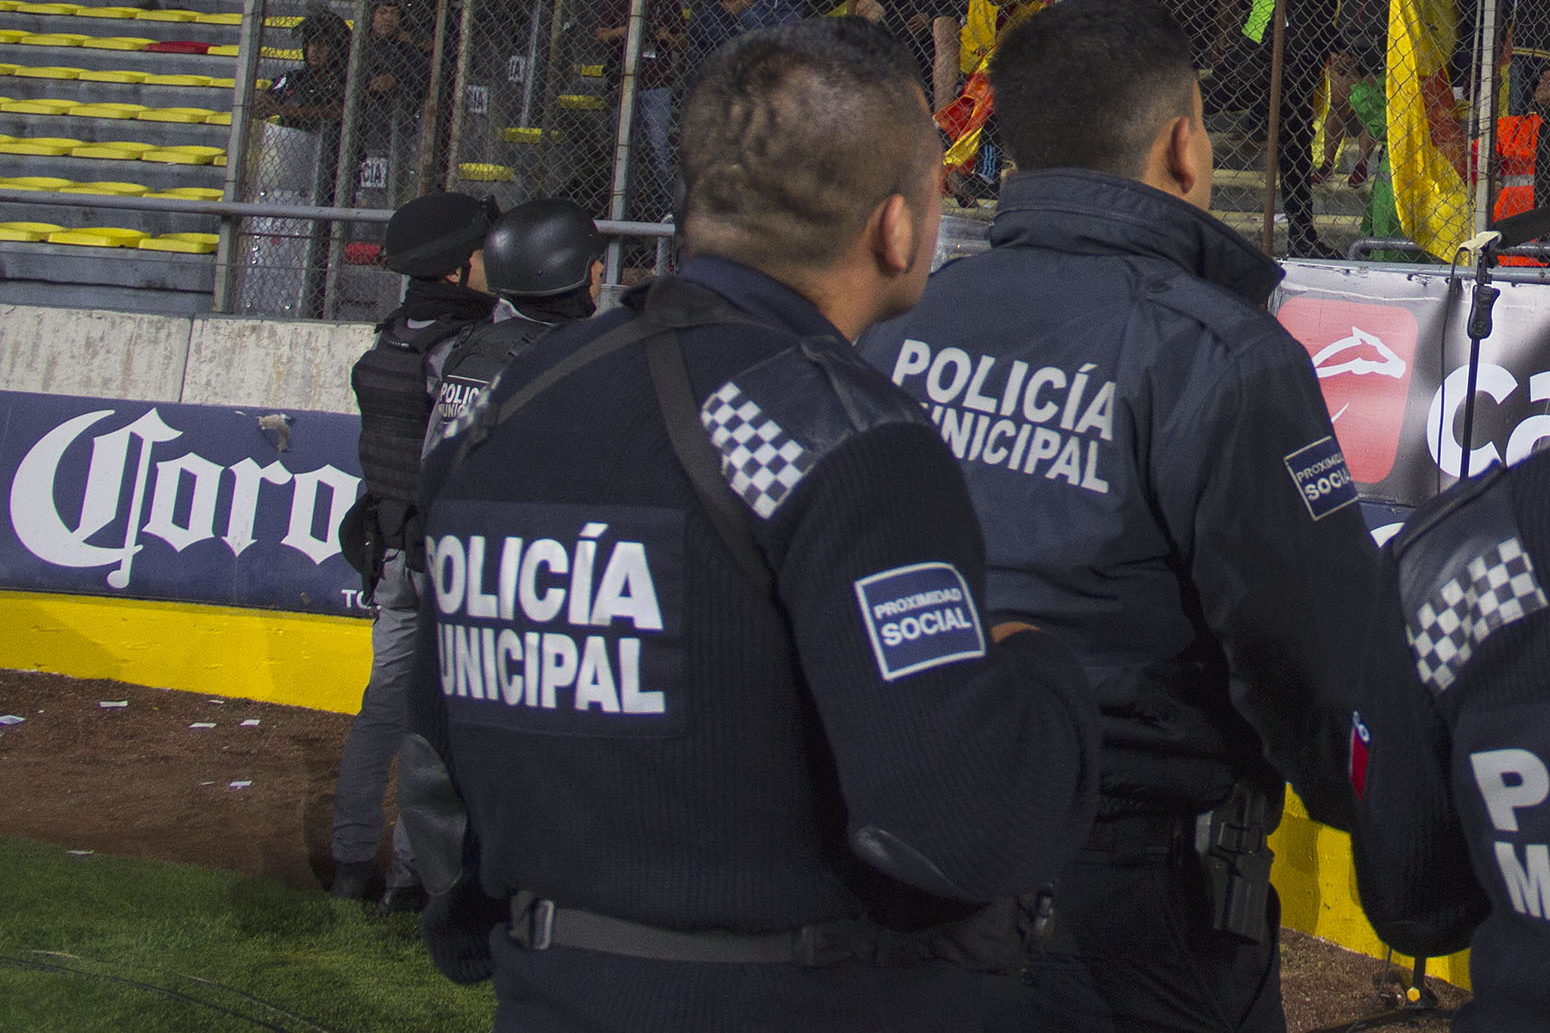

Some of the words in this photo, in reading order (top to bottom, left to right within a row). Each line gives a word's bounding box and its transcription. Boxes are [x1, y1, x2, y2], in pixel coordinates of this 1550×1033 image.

[891, 339, 1117, 441] POLICÍA
[10, 407, 362, 589] Coro
[873, 587, 963, 619] PROXIMIDAD
[880, 606, 973, 646] SOCIAL
[437, 621, 666, 714] UNICIPAL
